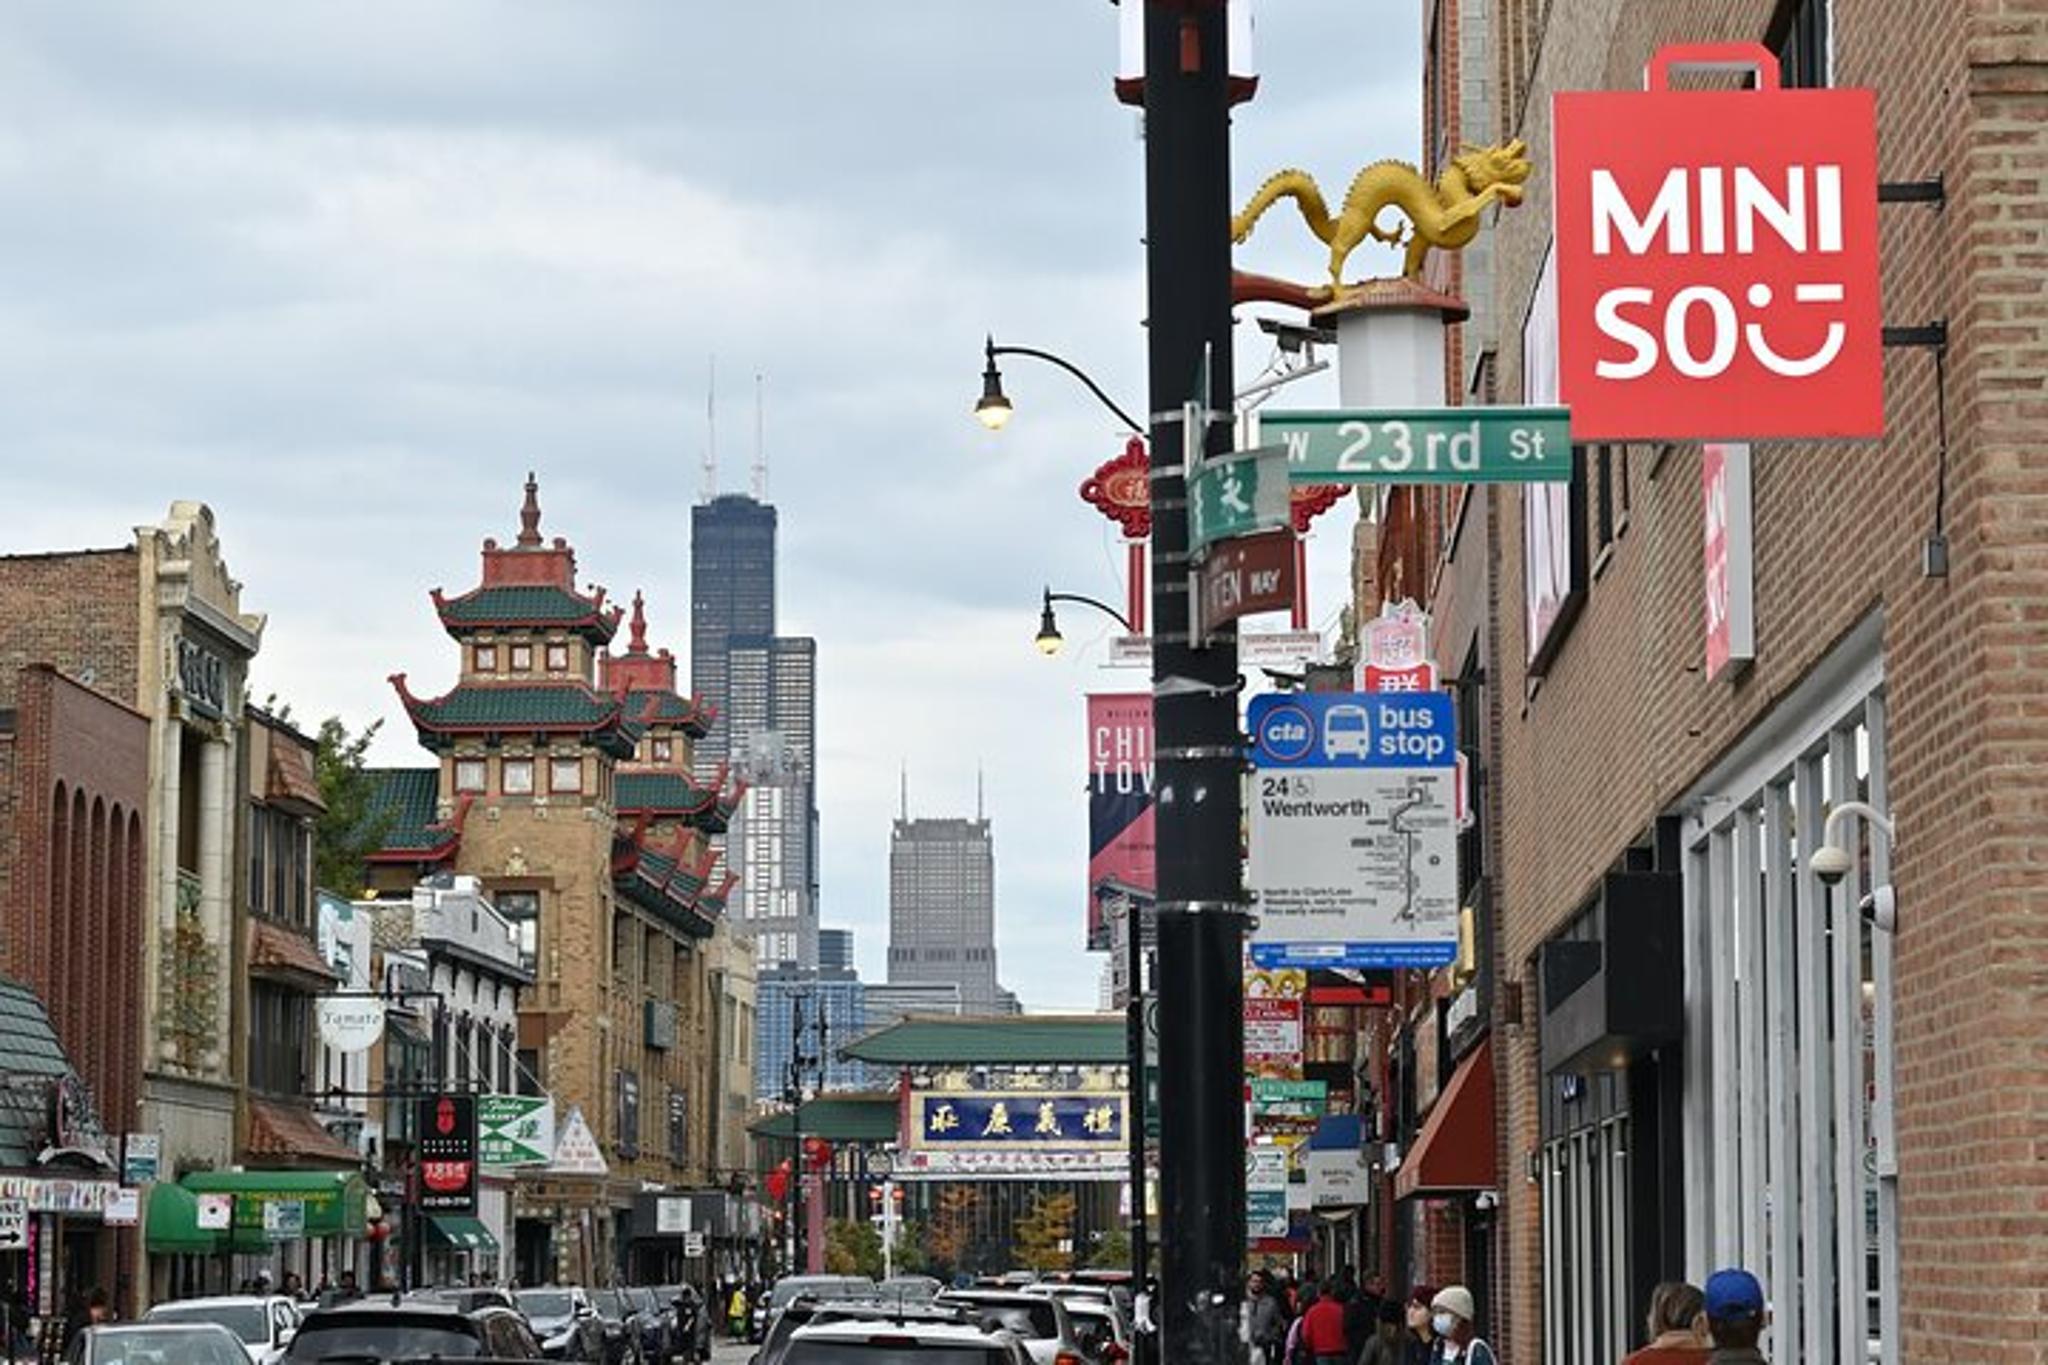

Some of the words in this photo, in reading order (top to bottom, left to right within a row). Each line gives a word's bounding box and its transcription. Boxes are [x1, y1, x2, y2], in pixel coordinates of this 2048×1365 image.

[1591, 165, 1843, 255] MINI
[1282, 431, 1310, 462] W
[1336, 420, 1480, 472] 23rd
[1508, 428, 1546, 460] St
[1379, 705, 1434, 728] bus
[1266, 723, 1307, 743] cta
[1379, 733, 1445, 761] stop
[1262, 778, 1289, 797] 24
[1262, 800, 1371, 817] Wentworth
